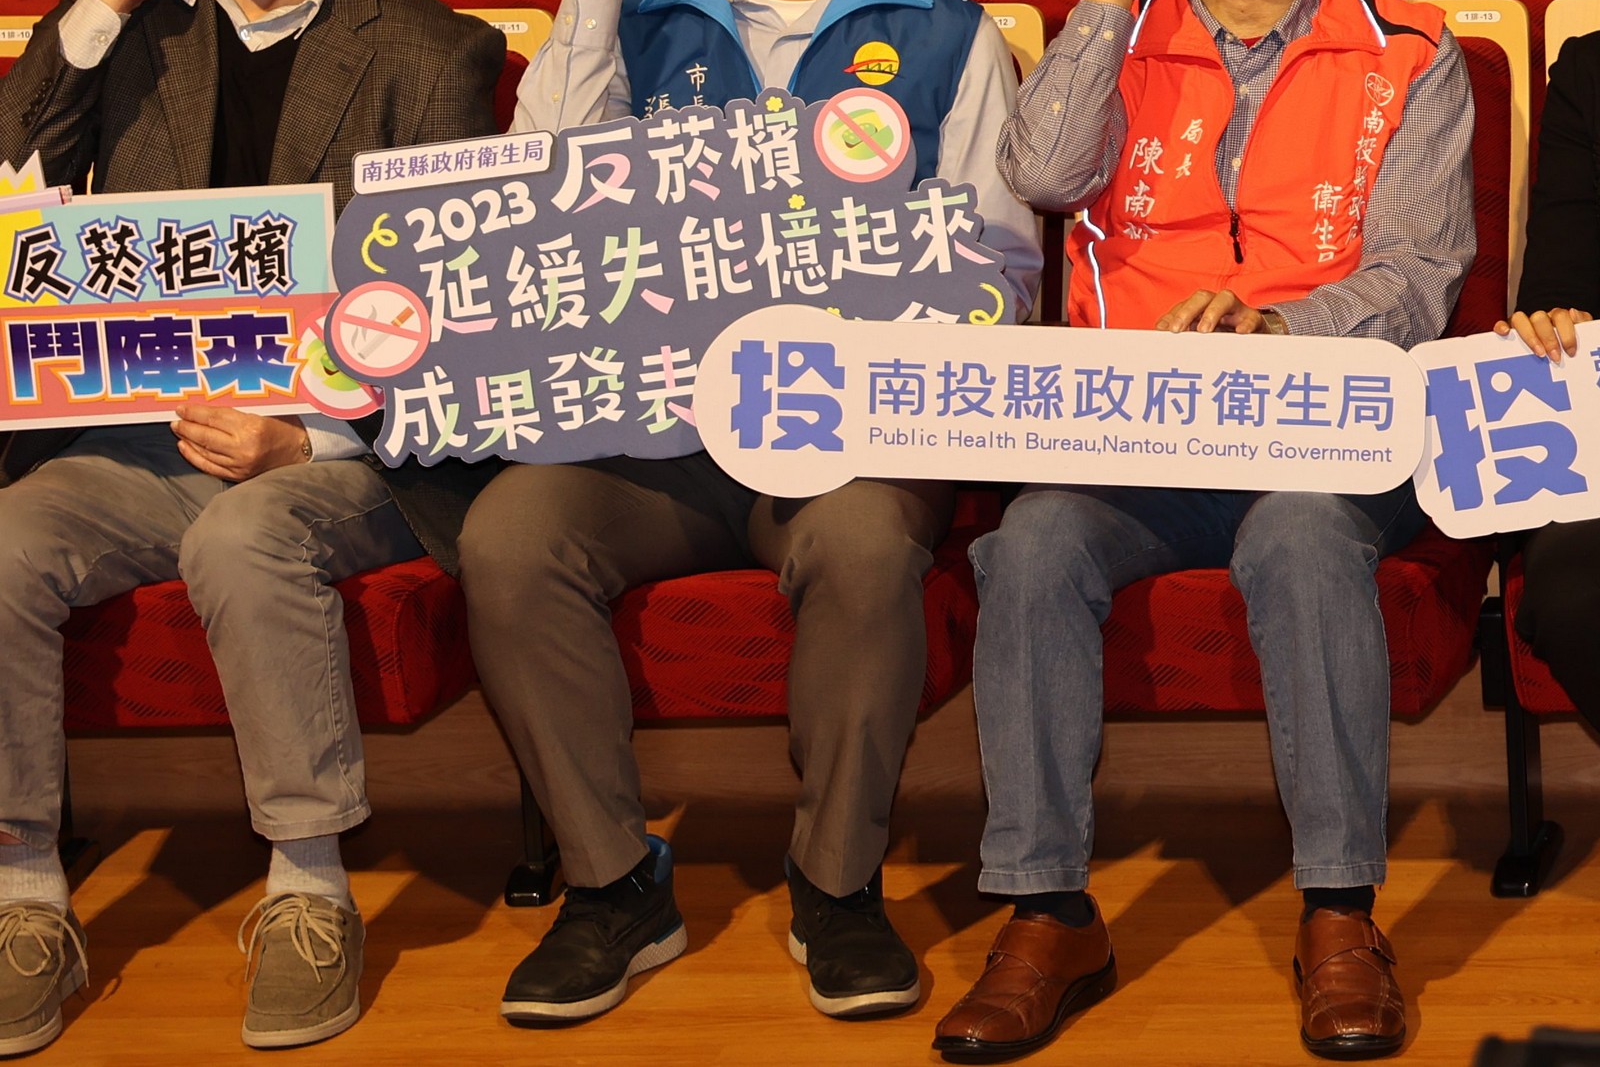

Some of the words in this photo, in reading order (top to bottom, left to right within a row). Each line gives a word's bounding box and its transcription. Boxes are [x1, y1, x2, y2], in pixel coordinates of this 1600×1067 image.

[361, 138, 544, 184] 南投縣政府衛生局
[405, 181, 537, 253] 2023
[551, 107, 804, 214] 反菸檳
[1175, 118, 1203, 179] 局長
[9, 218, 293, 298] 反菸拒檳
[418, 187, 996, 344] 延緩失能憶起來
[7, 313, 300, 400] 鬥陣來
[868, 358, 1394, 432] 南投縣政府衛生局
[869, 427, 938, 446] Public
[947, 430, 1017, 449] Health
[1186, 438, 1259, 461] County
[1268, 440, 1393, 463] Government
